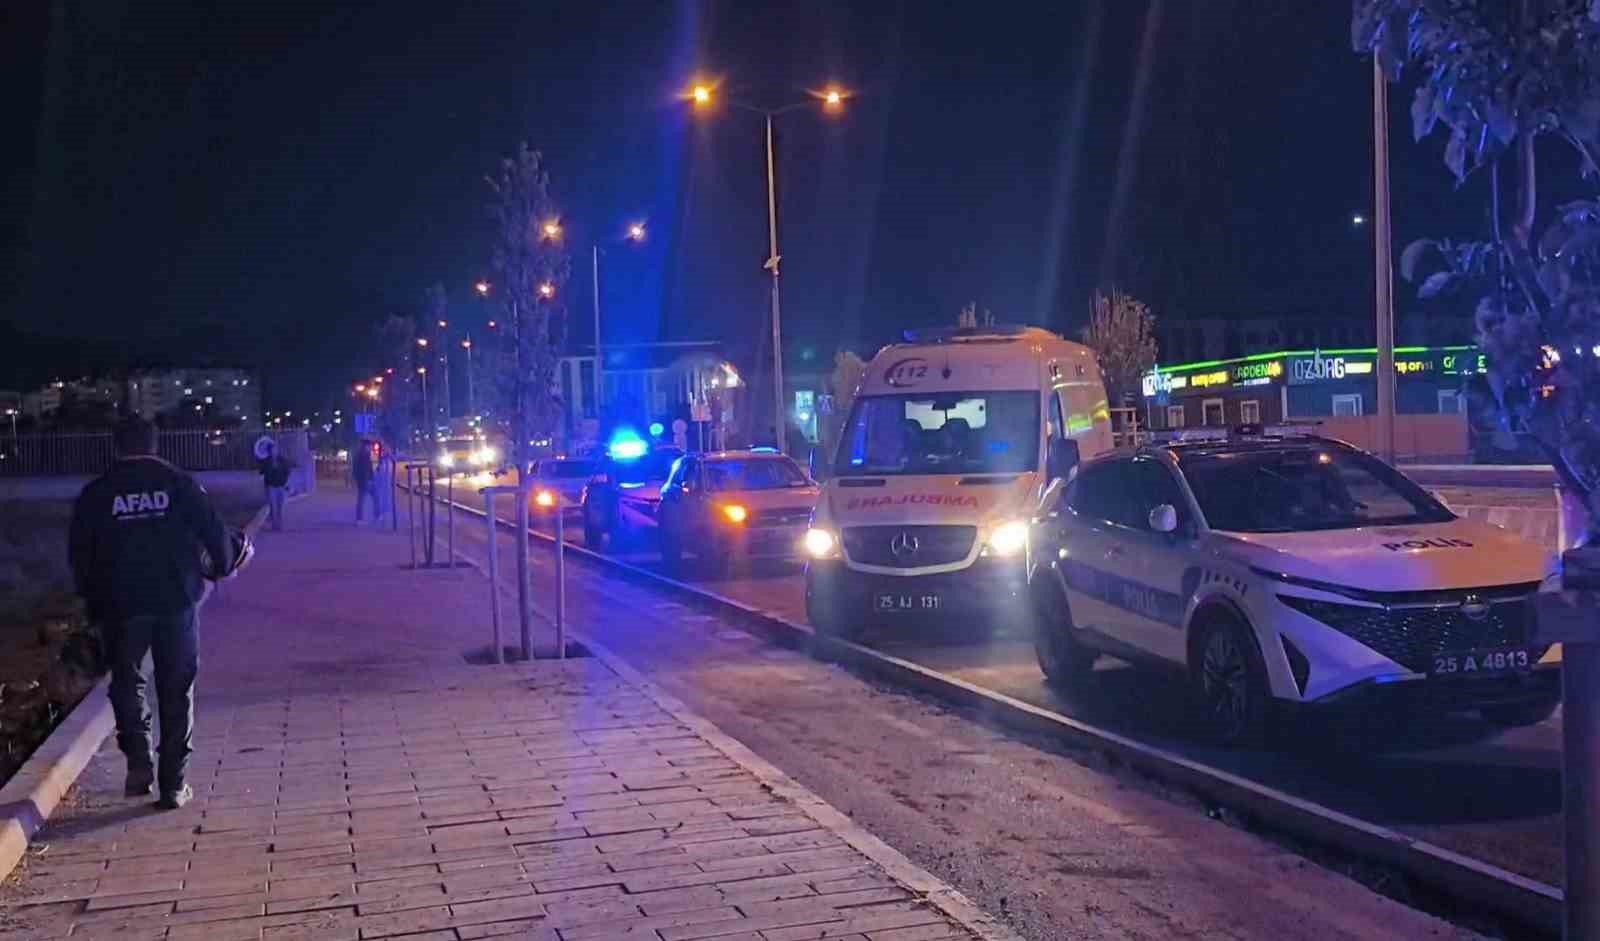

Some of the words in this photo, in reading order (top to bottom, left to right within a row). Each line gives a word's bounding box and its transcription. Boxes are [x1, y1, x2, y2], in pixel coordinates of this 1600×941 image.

[896, 366, 928, 378] 112
[112, 490, 170, 515] AFAD
[880, 596, 894, 608] 25
[899, 596, 912, 608] AJ
[921, 596, 939, 608] 131
[1434, 658, 1457, 673] 25
[1463, 656, 1478, 672] A
[1482, 650, 1528, 670] 4813
